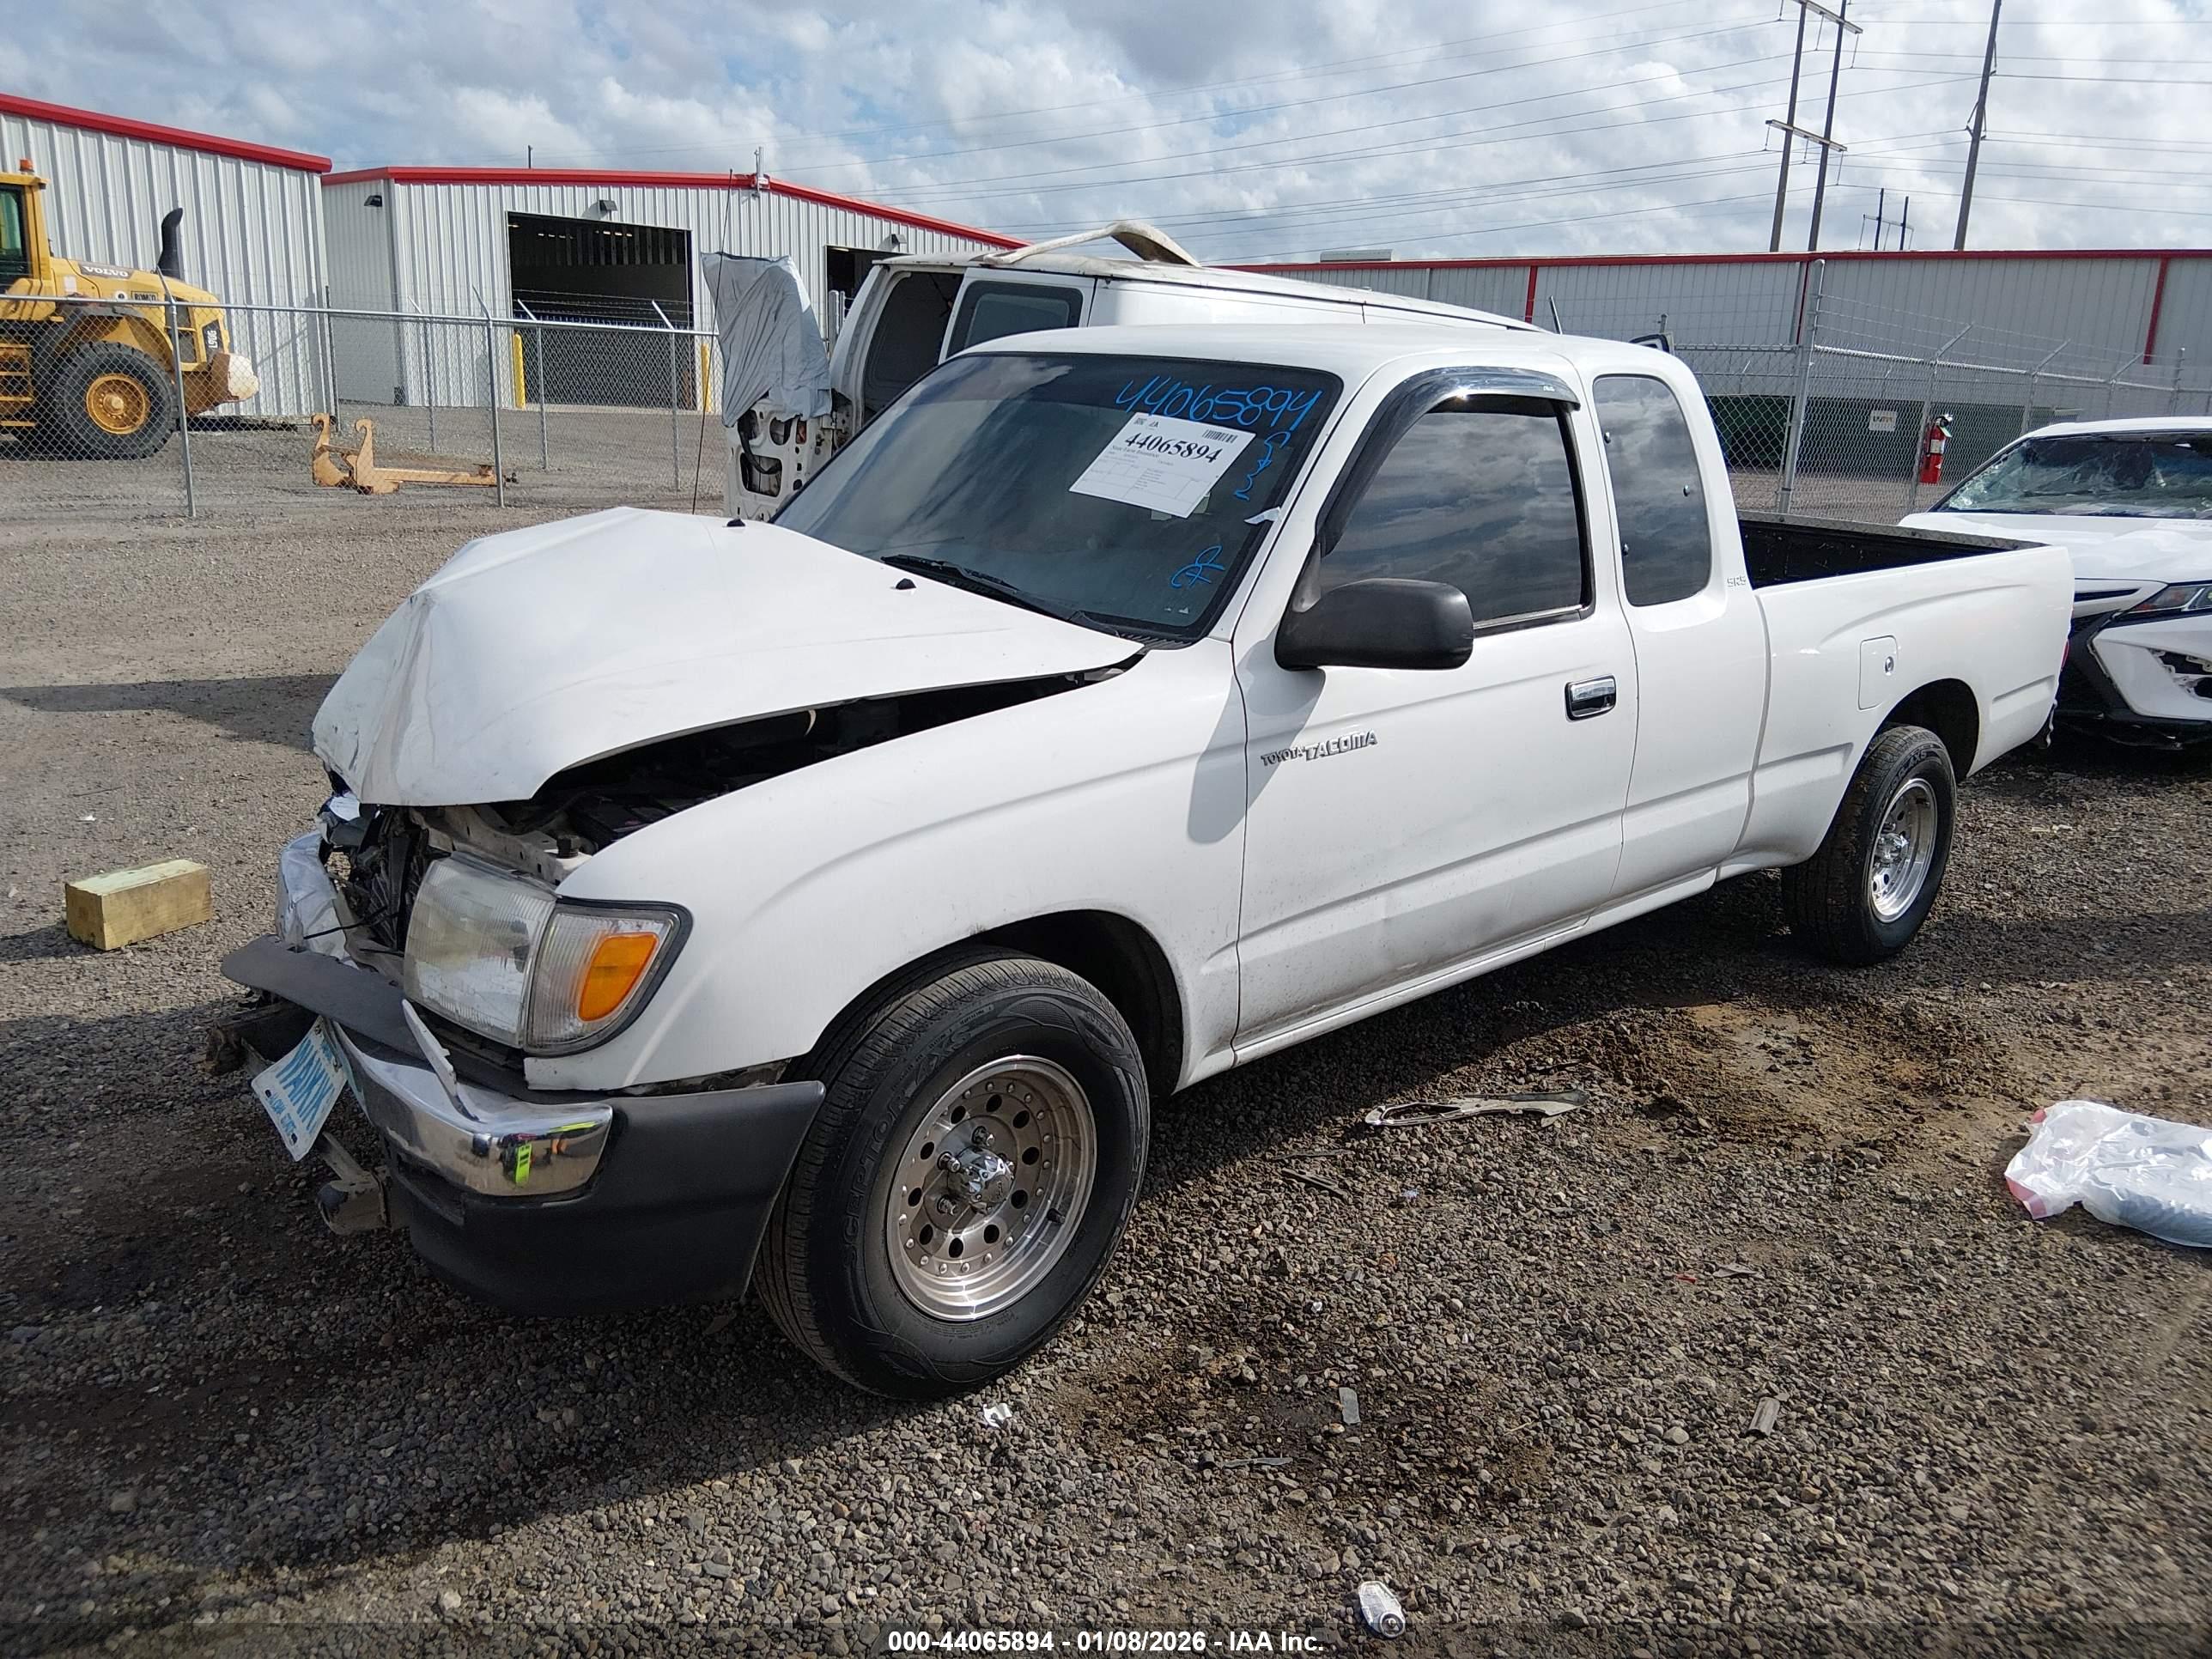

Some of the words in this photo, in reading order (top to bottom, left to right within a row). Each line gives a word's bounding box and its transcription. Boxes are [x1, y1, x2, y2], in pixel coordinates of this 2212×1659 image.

[82, 265, 129, 277] VOLVO
[1115, 376, 1323, 430] 44065894
[1125, 432, 1223, 464] 44065894
[1261, 746, 1306, 767] TOYOTA
[1304, 731, 1377, 761] TACOMA
